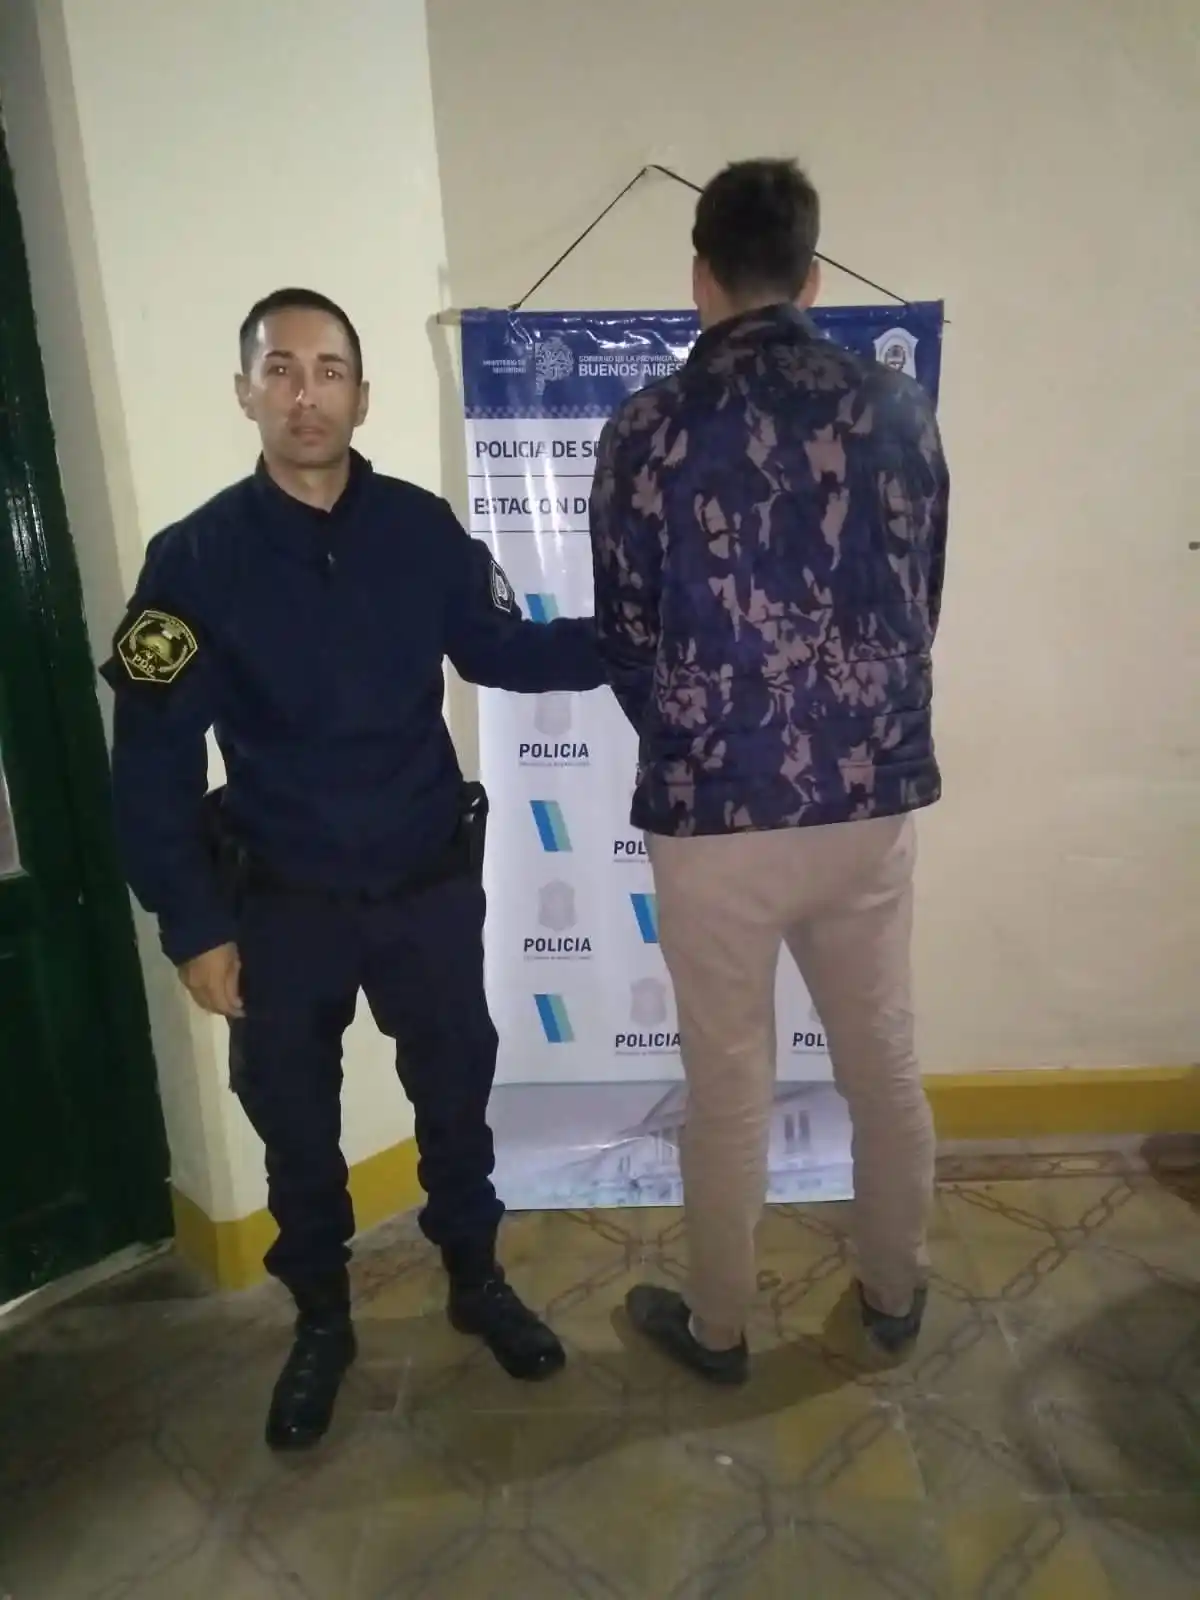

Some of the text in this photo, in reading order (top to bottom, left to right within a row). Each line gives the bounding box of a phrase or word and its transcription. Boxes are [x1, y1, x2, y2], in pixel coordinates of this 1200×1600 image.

[579, 364, 638, 377] BUENOS
[476, 440, 549, 458] POLICIA
[552, 440, 577, 458] DE
[474, 497, 588, 515] ESTACON D
[519, 743, 589, 758] POLICIA
[613, 840, 647, 855] POL
[524, 937, 592, 952] POLICIA
[615, 1033, 681, 1048] POLICIA
[792, 1032, 826, 1047] POL
